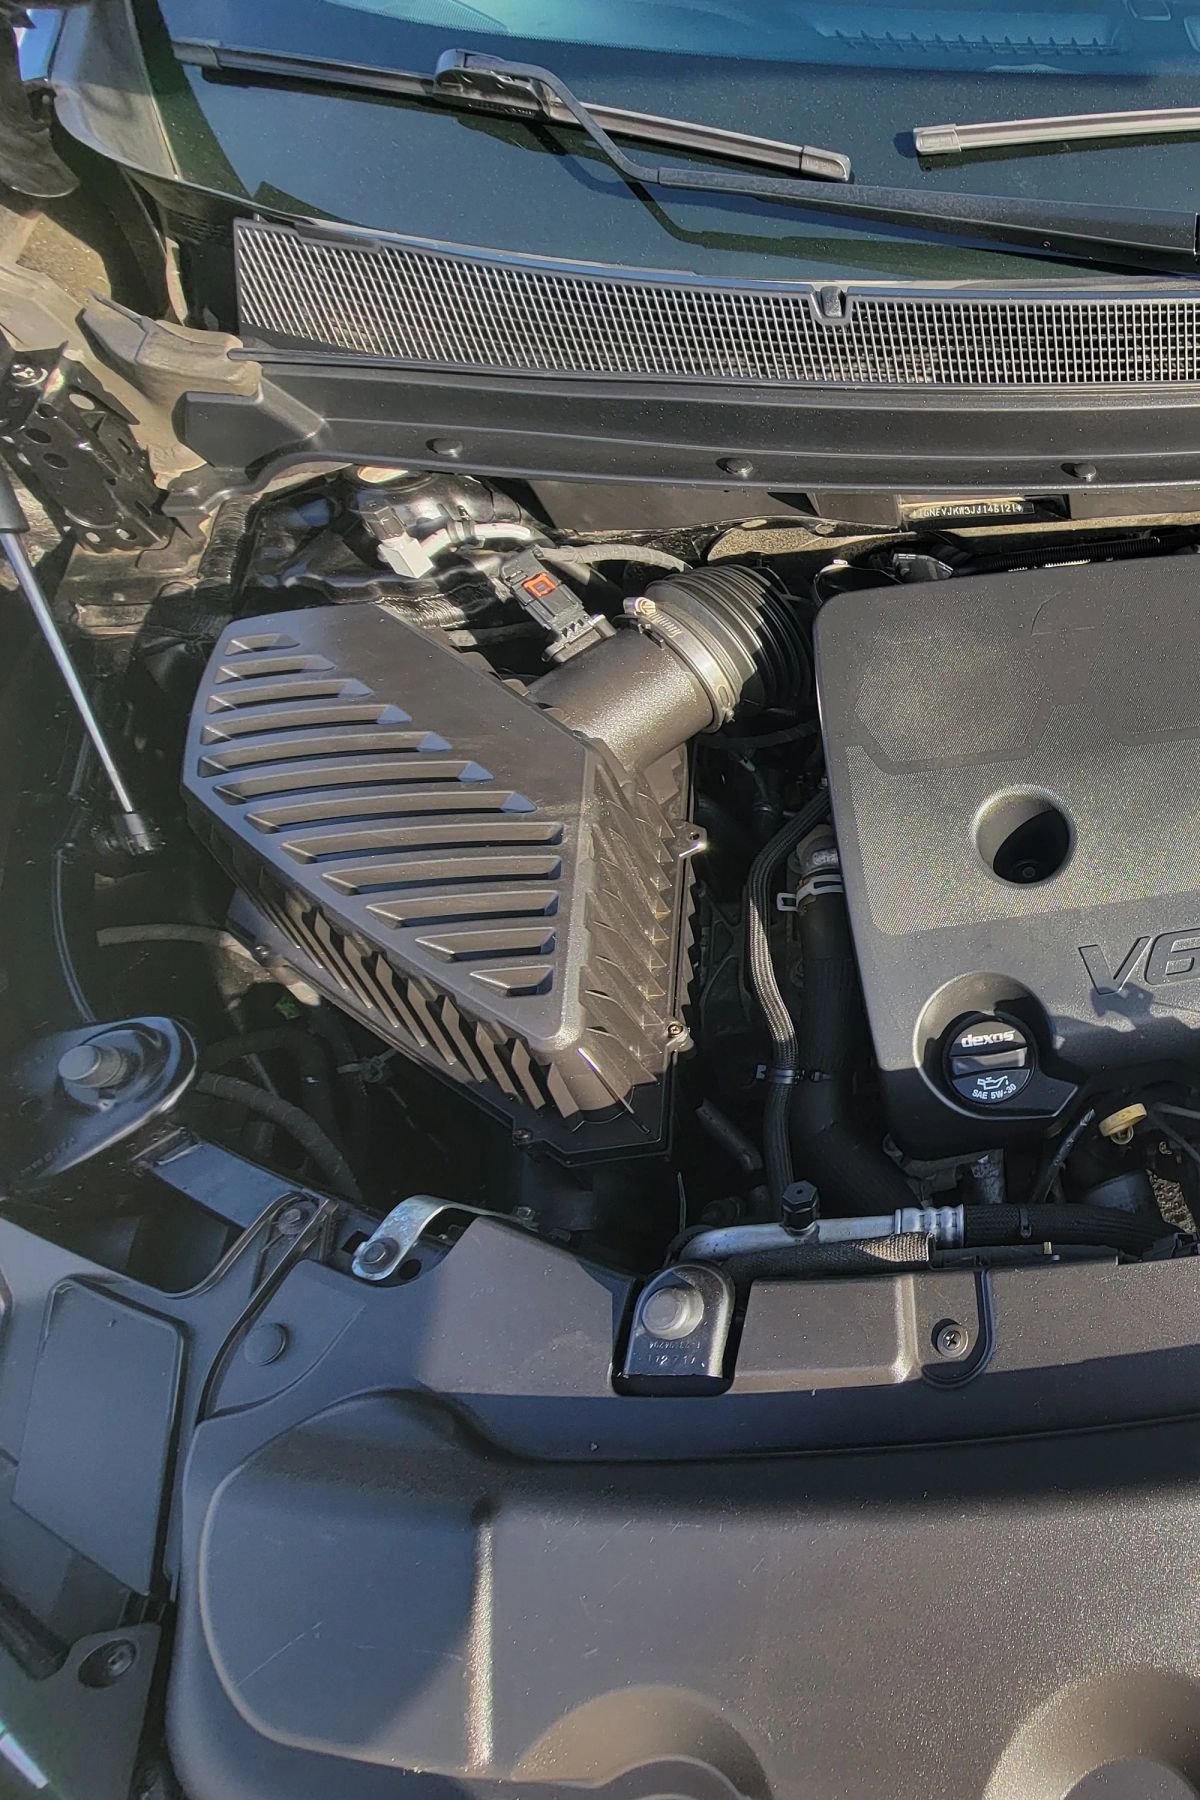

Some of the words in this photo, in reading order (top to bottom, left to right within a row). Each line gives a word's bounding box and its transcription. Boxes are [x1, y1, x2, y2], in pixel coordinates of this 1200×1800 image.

[961, 1030, 1016, 1048] dexos
[971, 1088, 989, 1100] SAE
[990, 1083, 1017, 1100] 5W-30
